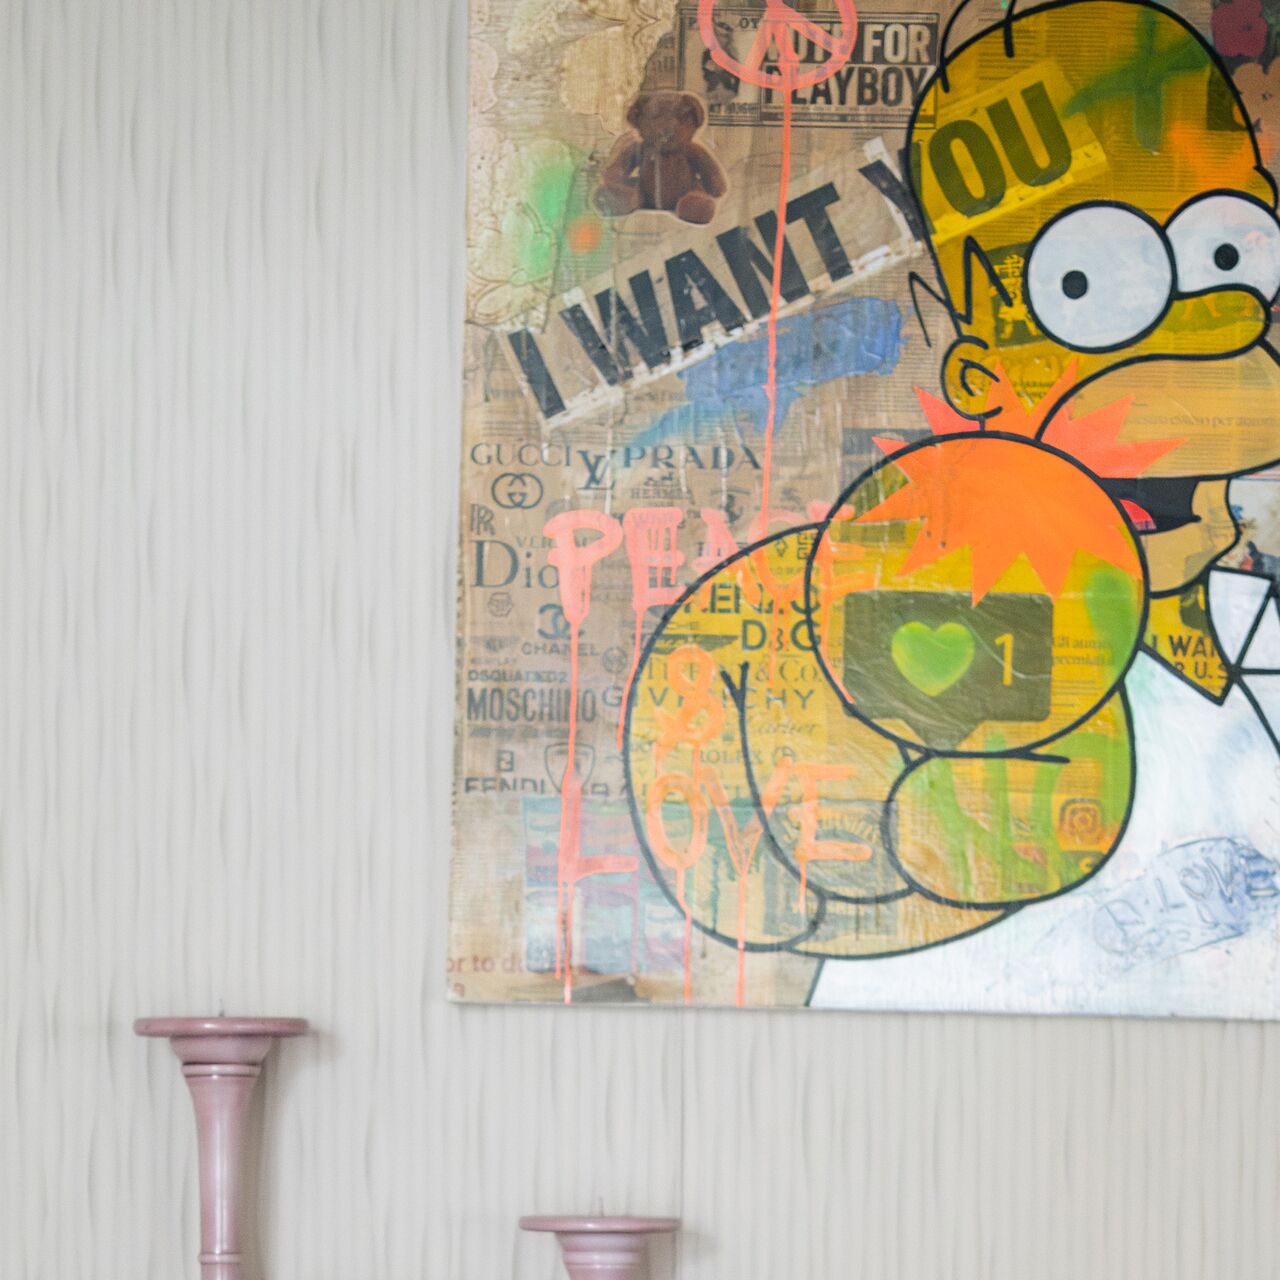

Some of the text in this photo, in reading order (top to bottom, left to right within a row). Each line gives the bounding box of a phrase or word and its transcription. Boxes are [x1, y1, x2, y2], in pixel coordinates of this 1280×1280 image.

[864, 24, 930, 63] FOR
[764, 66, 928, 106] PLAYBOY
[508, 81, 1072, 420] I WANT YOU
[471, 443, 571, 467] GUCCI
[624, 446, 762, 470] PRADA
[470, 540, 561, 588] Dio
[522, 642, 600, 657] CHANEL
[995, 634, 1013, 686] 1
[466, 685, 598, 722] MOSCHINO
[464, 776, 546, 794] FENDI
